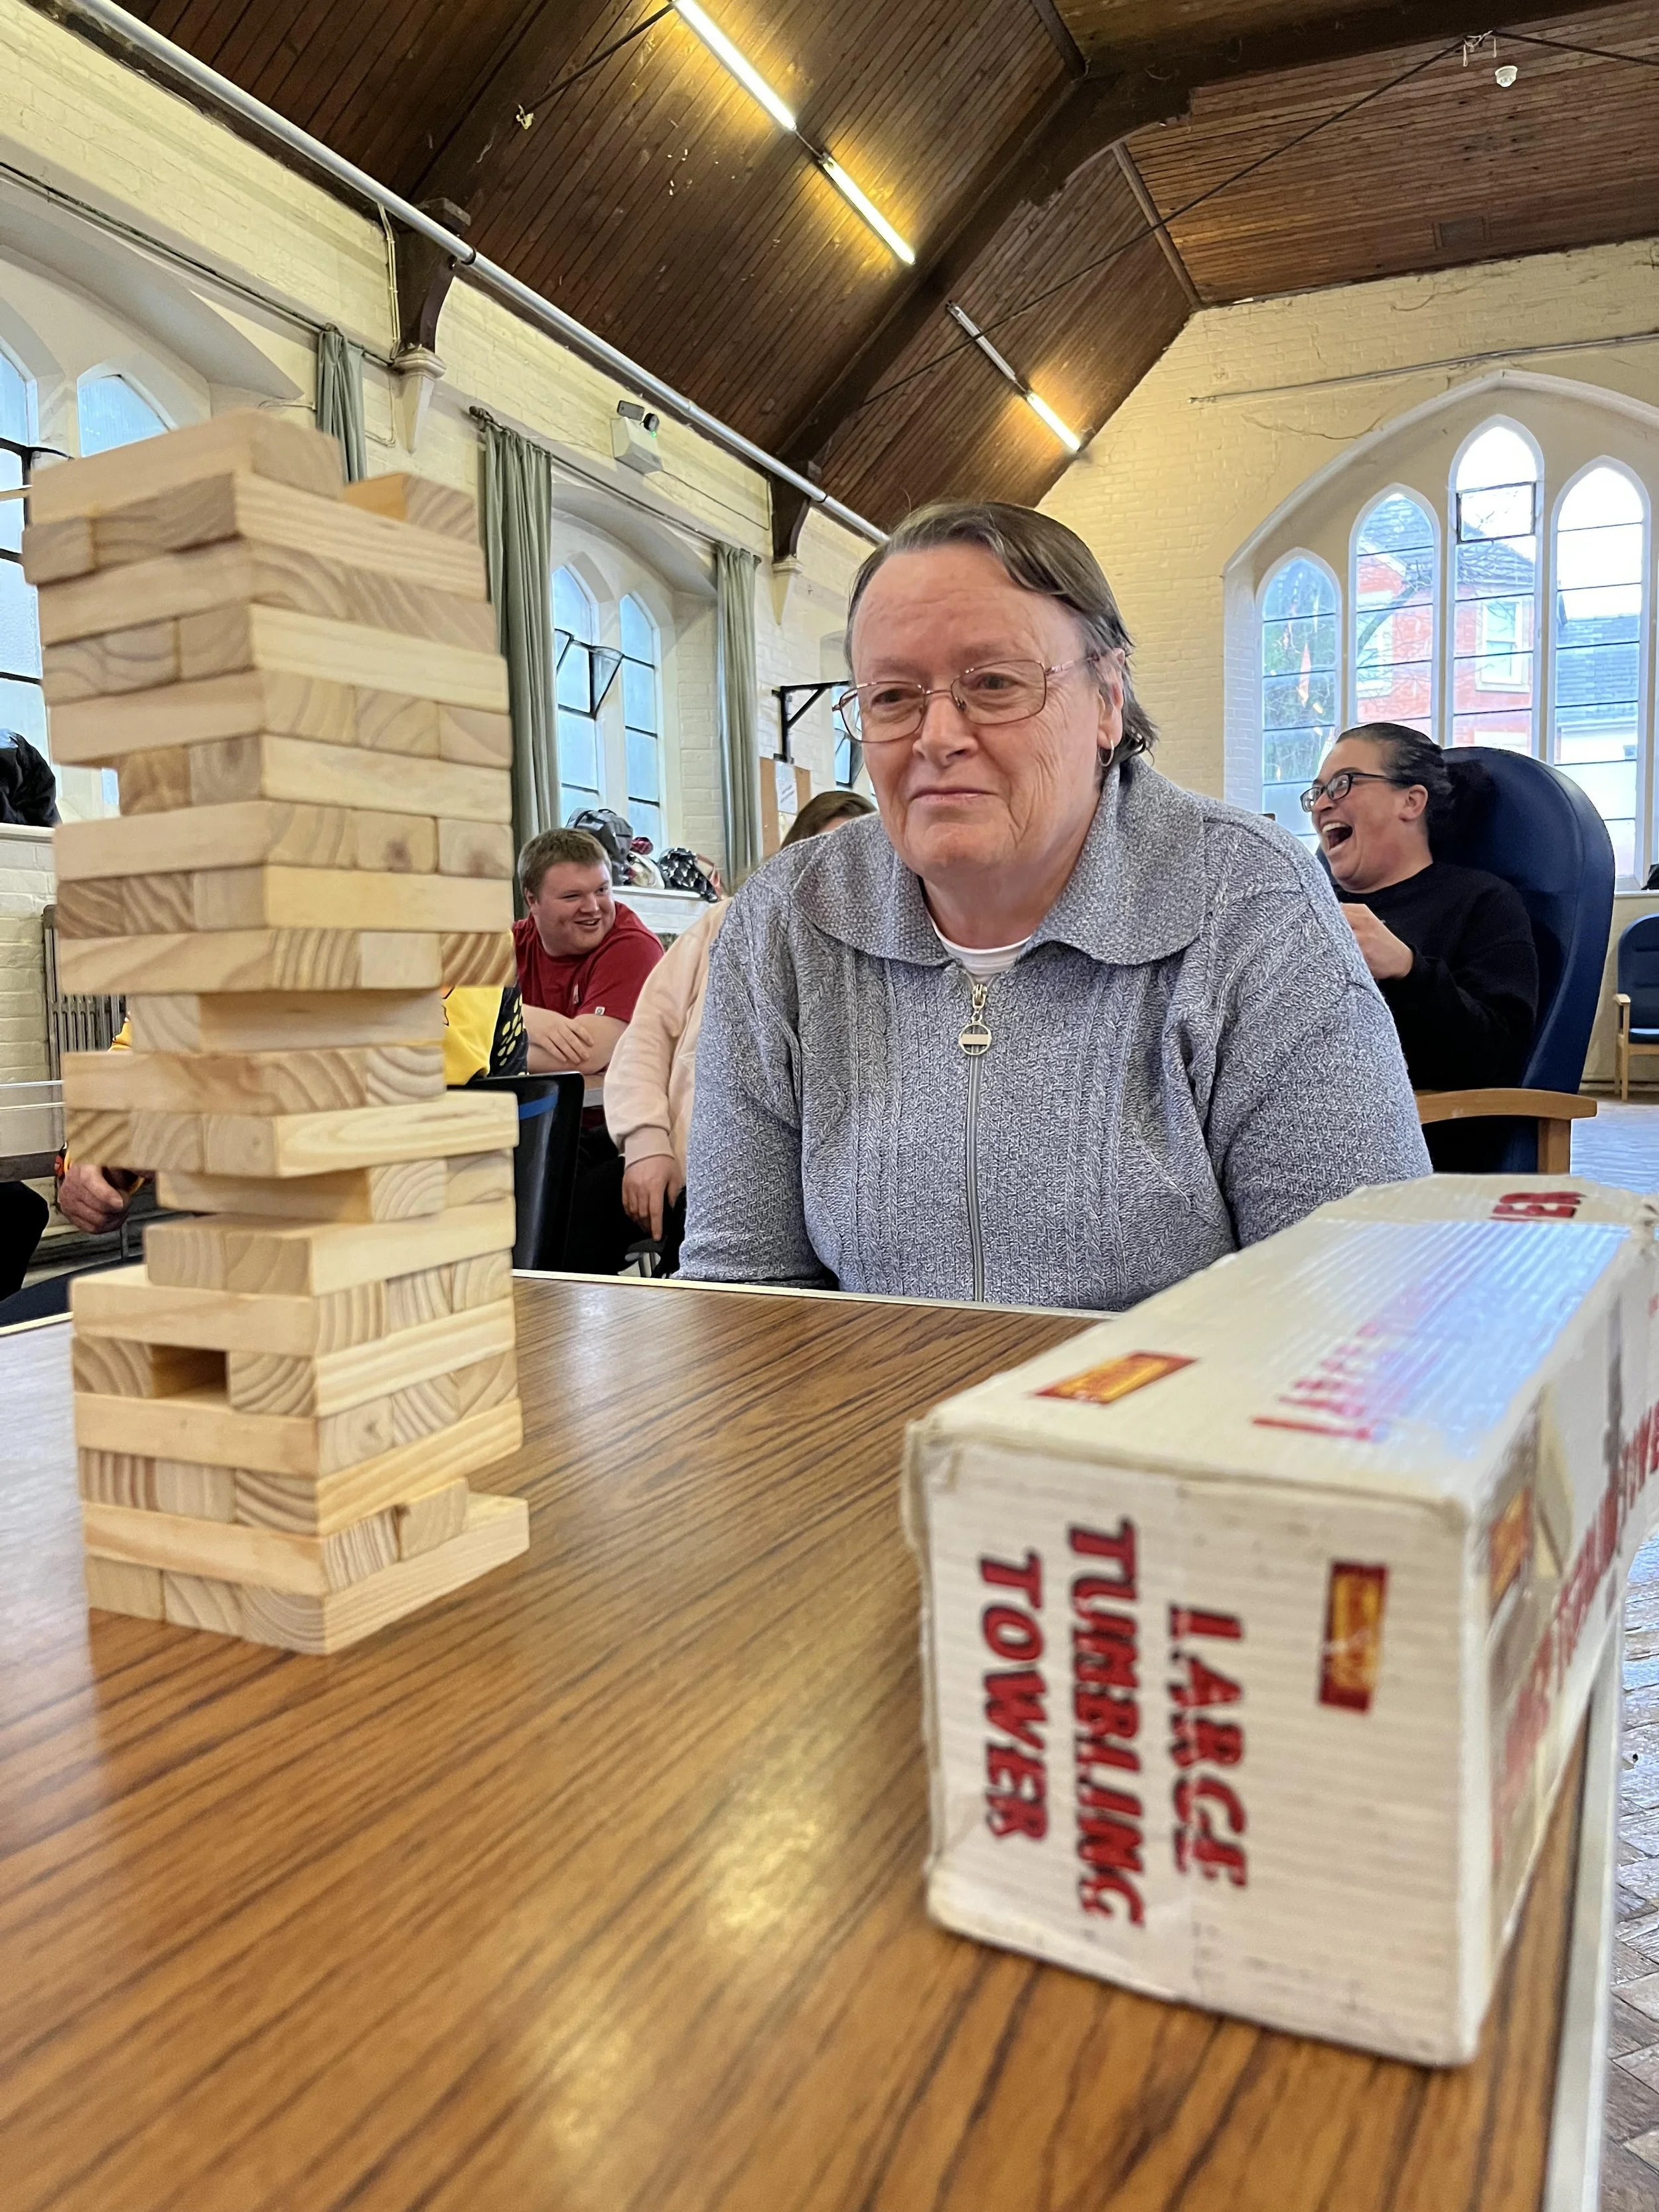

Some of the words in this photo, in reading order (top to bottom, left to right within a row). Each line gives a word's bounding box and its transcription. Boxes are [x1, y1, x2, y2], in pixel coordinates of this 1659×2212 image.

[979, 1549, 1050, 1842] TOWER
[1067, 1516, 1145, 1927] TUMBLING
[1169, 1603, 1248, 1889] LARGE
